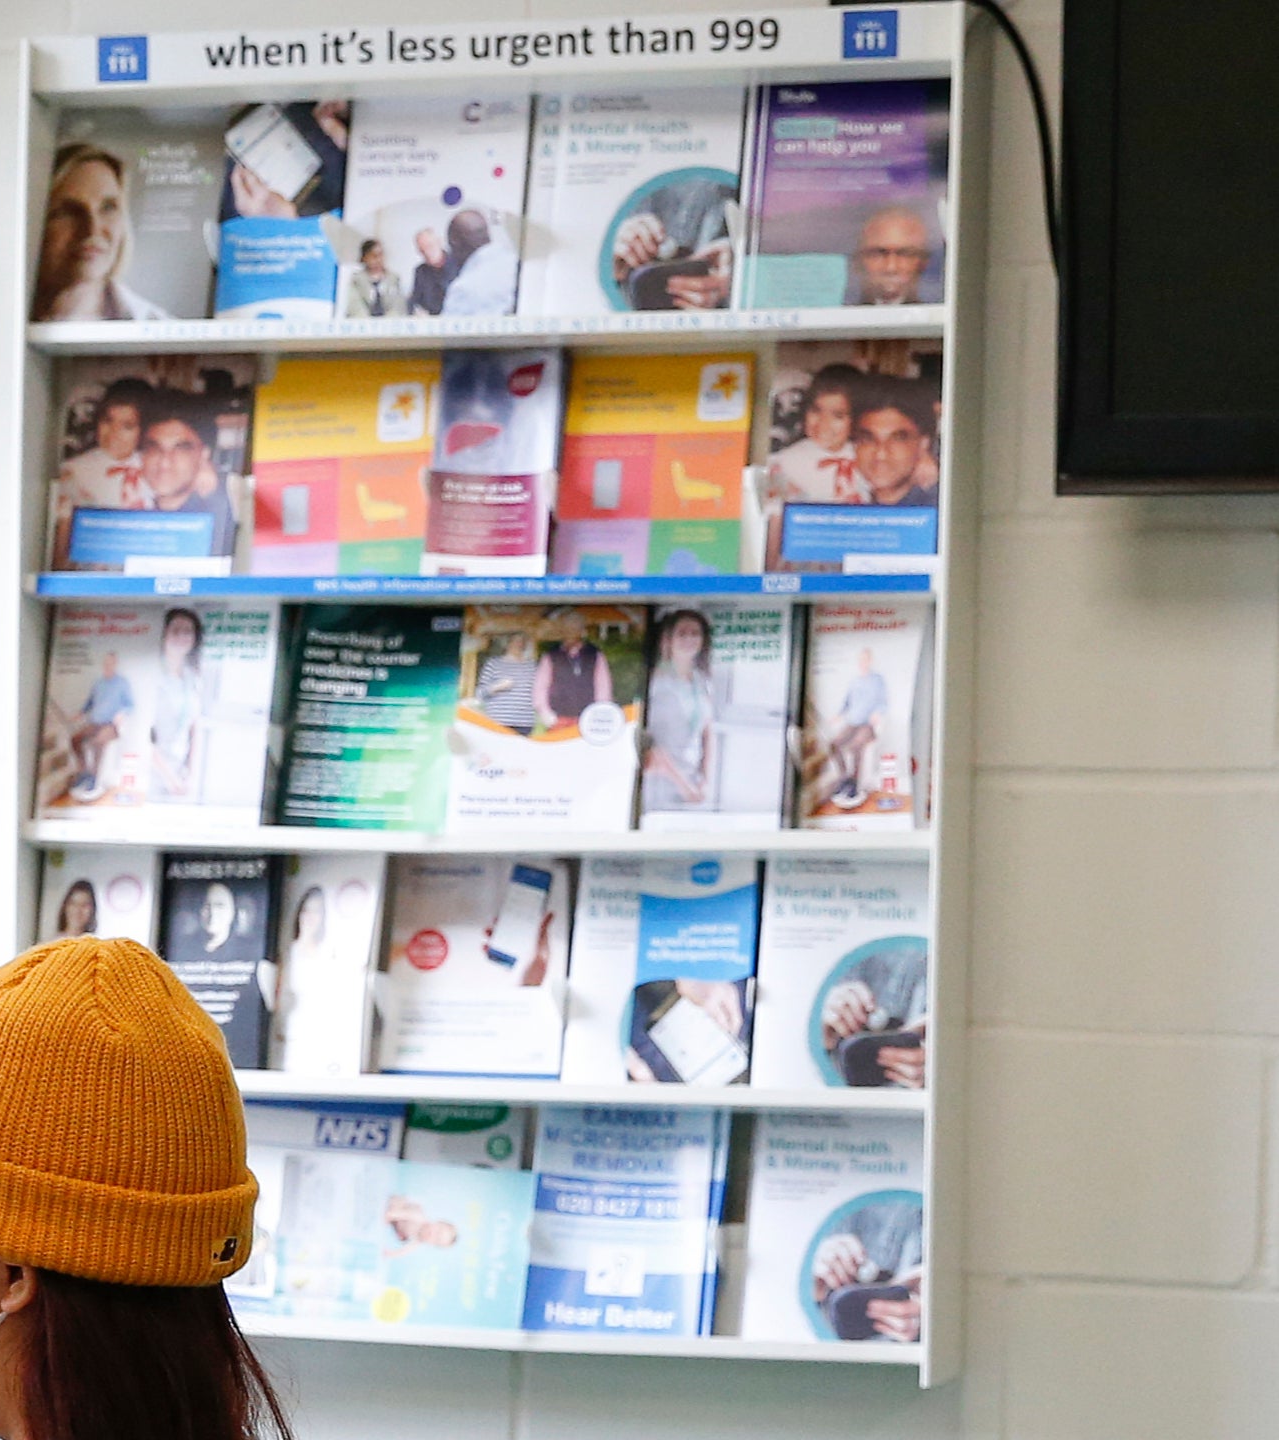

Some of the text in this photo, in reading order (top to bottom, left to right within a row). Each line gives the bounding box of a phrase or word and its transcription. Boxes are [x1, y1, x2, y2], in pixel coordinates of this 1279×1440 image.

[205, 18, 781, 68] when it's less urgent than 999
[307, 629, 406, 651] Prescribing of
[303, 646, 423, 666] over the counter
[302, 662, 374, 681] medicines
[300, 677, 369, 699] changing
[589, 885, 641, 902] Menta
[775, 884, 898, 902] Mental Health
[793, 904, 853, 922] Money
[858, 905, 917, 921] Toolkit
[318, 1120, 388, 1149] NHS
[767, 1137, 888, 1154] Mental Health
[784, 1157, 842, 1175] Money
[849, 1159, 908, 1174] Toolkit
[544, 1301, 678, 1330] Hear Better
